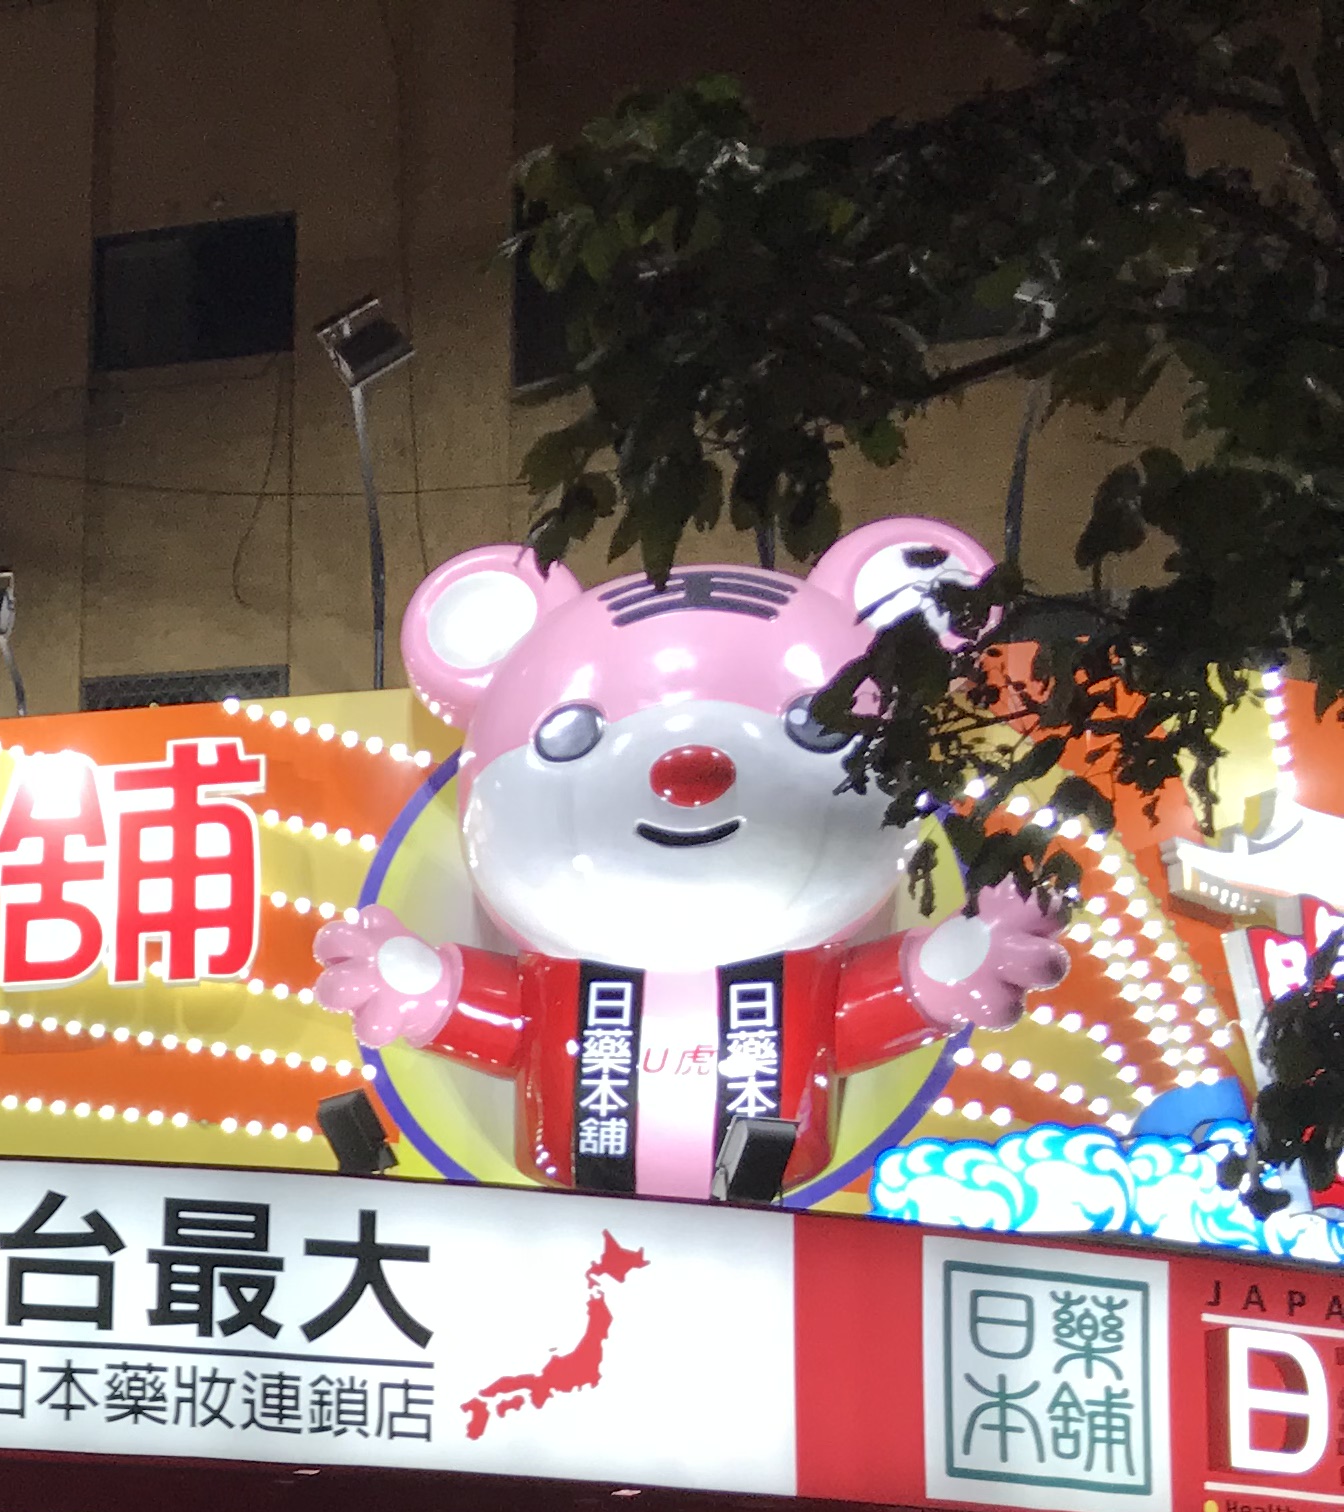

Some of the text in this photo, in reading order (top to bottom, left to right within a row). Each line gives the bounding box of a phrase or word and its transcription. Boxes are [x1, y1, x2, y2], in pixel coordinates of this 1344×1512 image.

[578, 980, 634, 1156] 日藥本舖
[725, 980, 779, 1118] 日藥本
